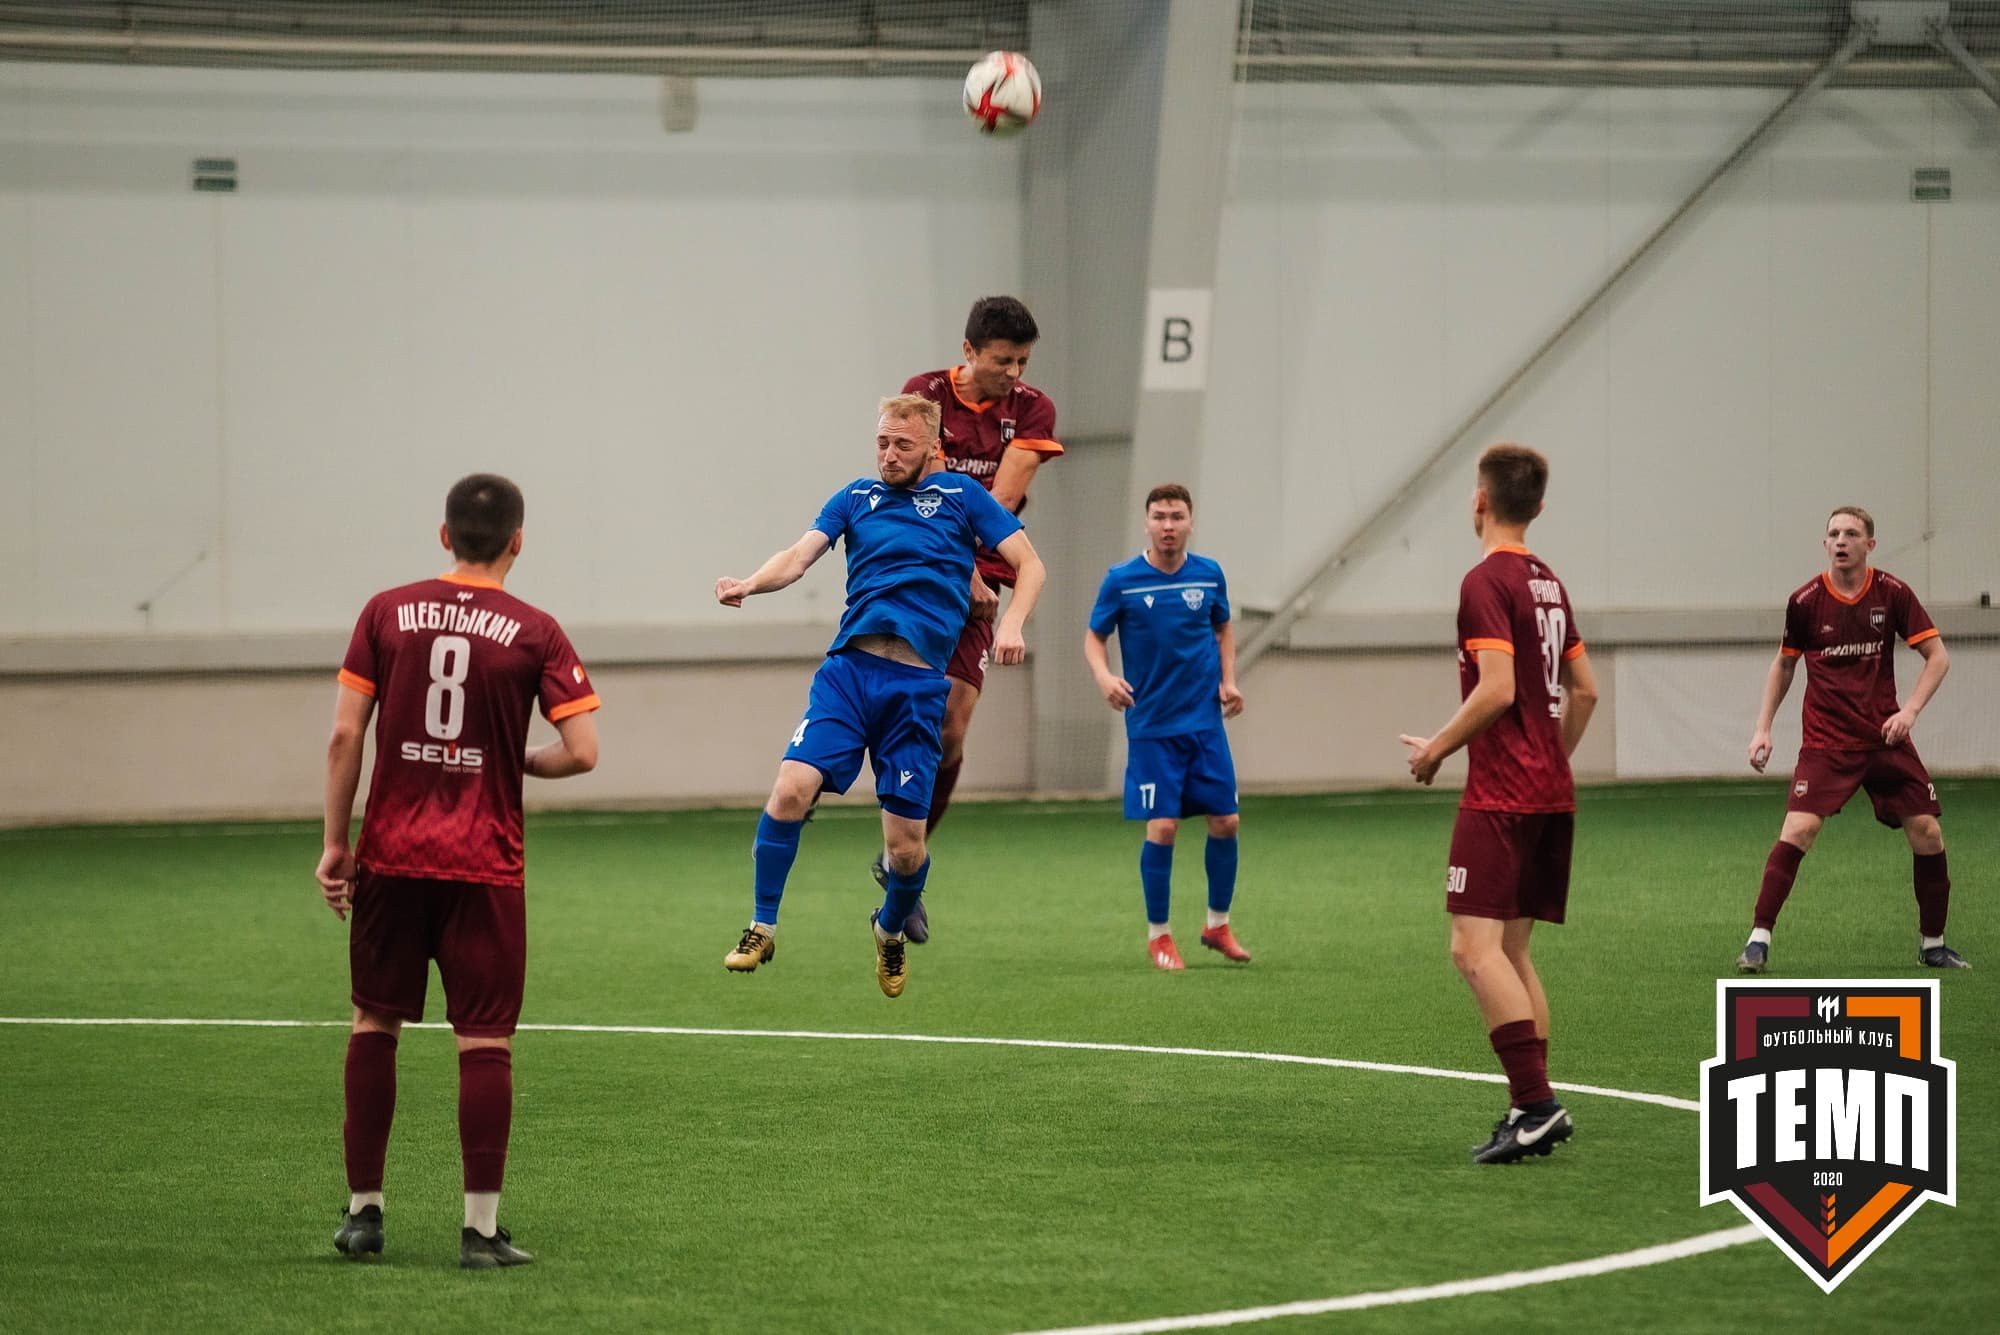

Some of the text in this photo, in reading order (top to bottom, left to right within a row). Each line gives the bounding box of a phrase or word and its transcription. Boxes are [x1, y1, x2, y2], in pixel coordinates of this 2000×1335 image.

[397, 600, 521, 647] ЩЕБЛЫКИН
[424, 635, 471, 741] 8
[791, 718, 810, 747] 4
[401, 741, 483, 767] SEUS
[1139, 783, 1156, 809] 17
[1447, 865, 1468, 894] 30
